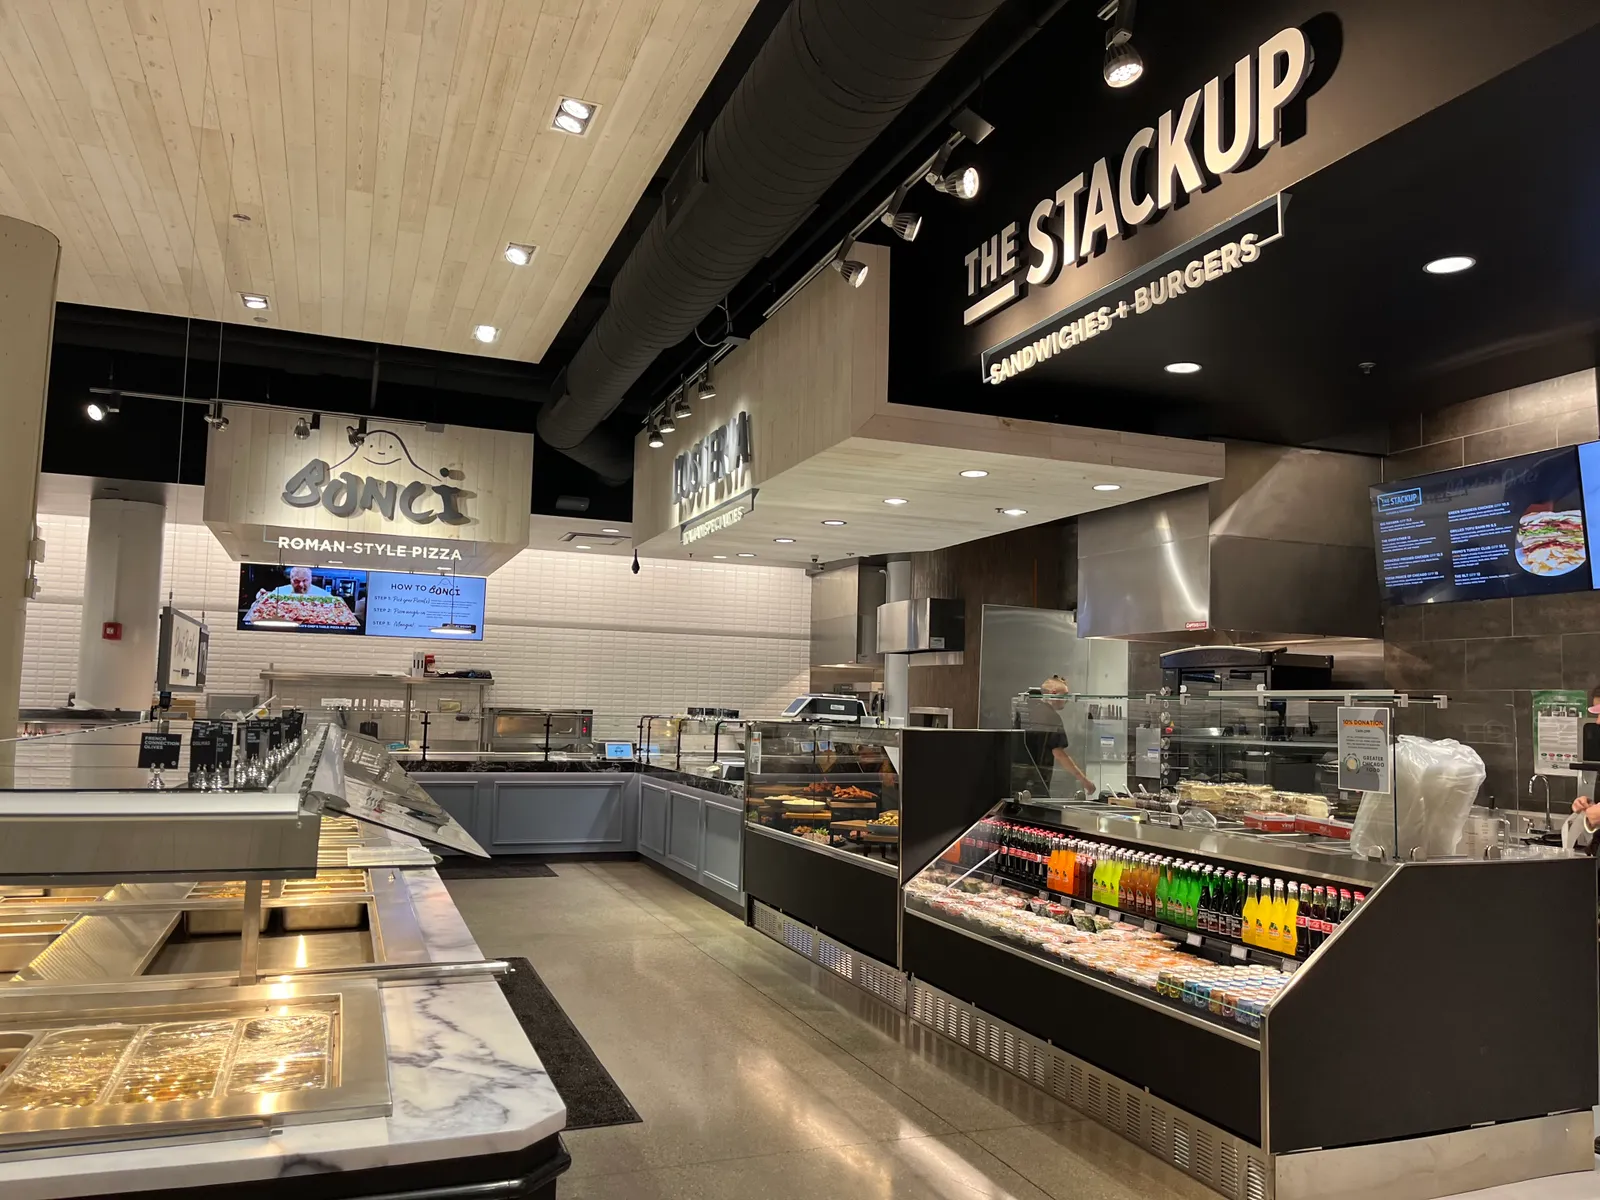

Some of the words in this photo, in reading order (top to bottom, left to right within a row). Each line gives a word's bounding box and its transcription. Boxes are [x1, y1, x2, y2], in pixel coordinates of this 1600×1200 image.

[964, 222, 1019, 297] THE
[1026, 27, 1310, 284] STACKUP
[989, 305, 1112, 385] SANDWICHES
[1133, 232, 1261, 315] BURGERS
[282, 458, 473, 526] BONCI
[1391, 493, 1418, 504] STACKUP
[278, 536, 407, 557] ROMAN-STYLE
[412, 546, 463, 562] PIZZA
[391, 583, 413, 591] HOW
[416, 584, 427, 592] TO
